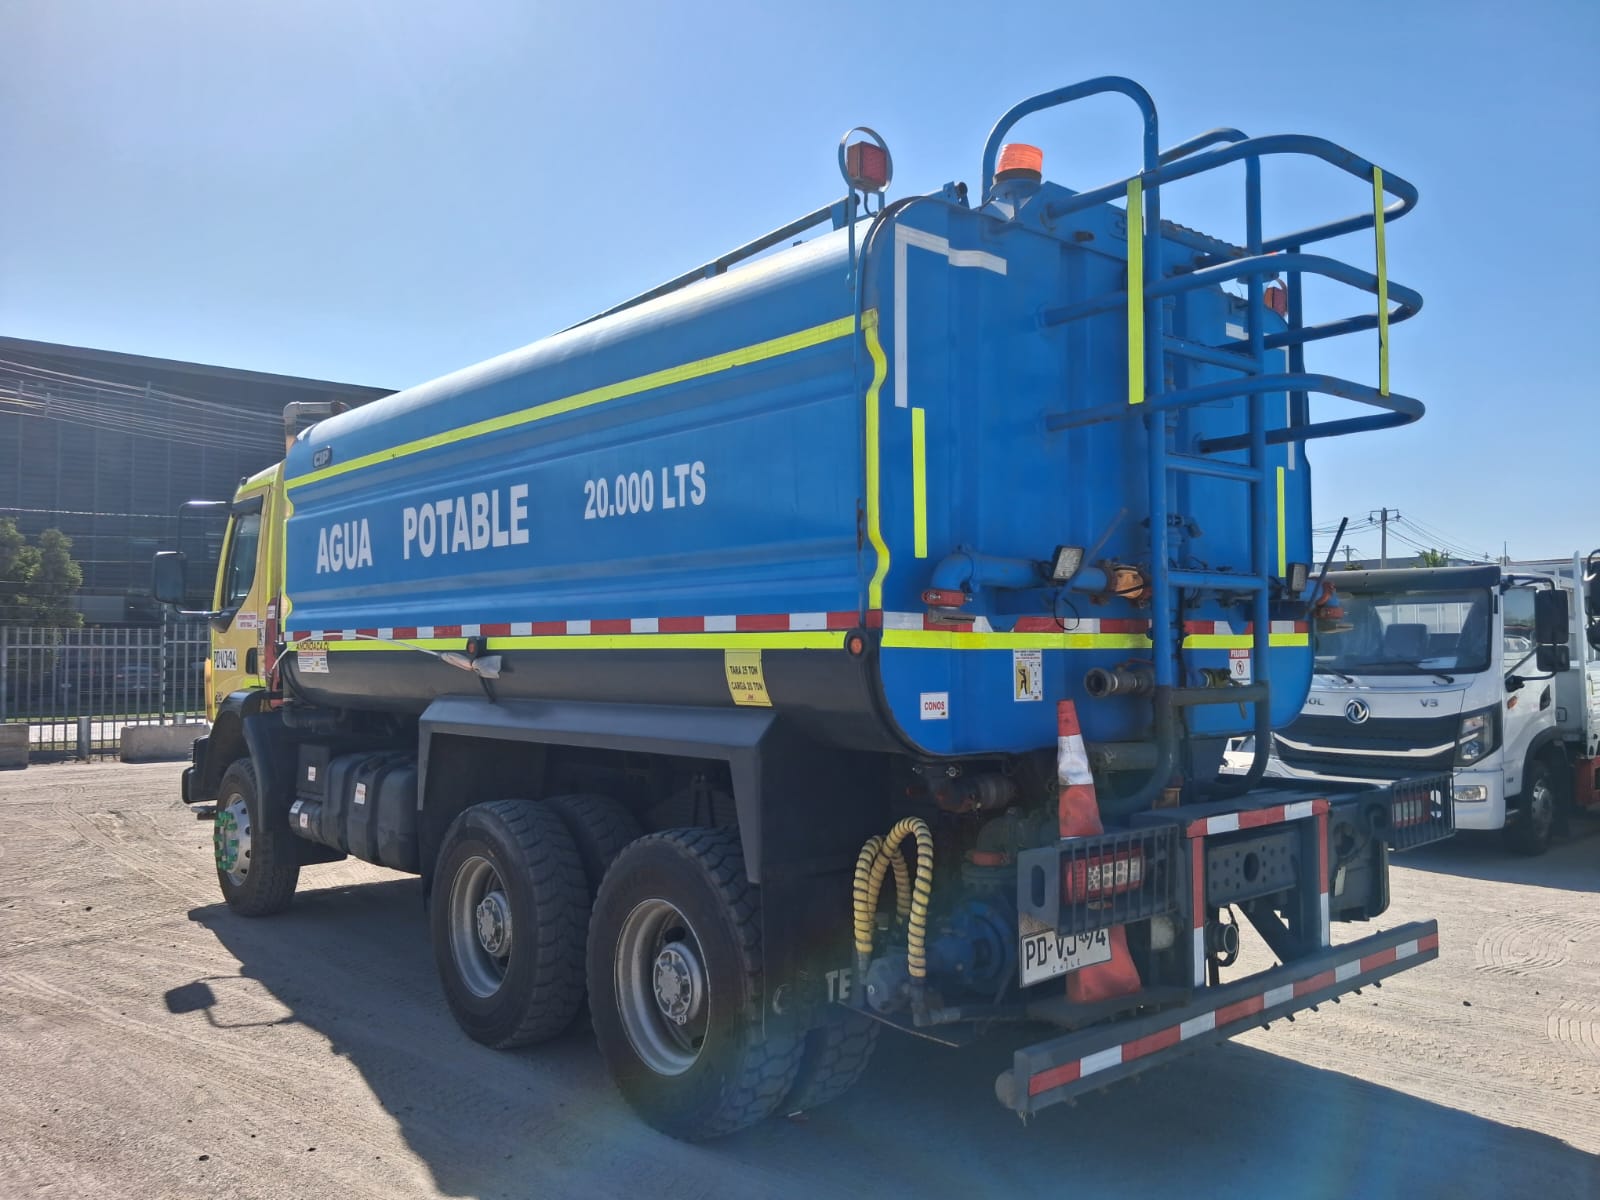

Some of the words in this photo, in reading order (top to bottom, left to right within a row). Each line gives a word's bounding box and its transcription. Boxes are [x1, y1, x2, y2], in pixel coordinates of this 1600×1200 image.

[583, 468, 654, 520] 20.000
[661, 460, 706, 508] LTS
[315, 518, 373, 574] AGUA
[403, 483, 530, 560] POTABLE
[924, 701, 945, 711] CONOS
[1420, 699, 1439, 708] V3
